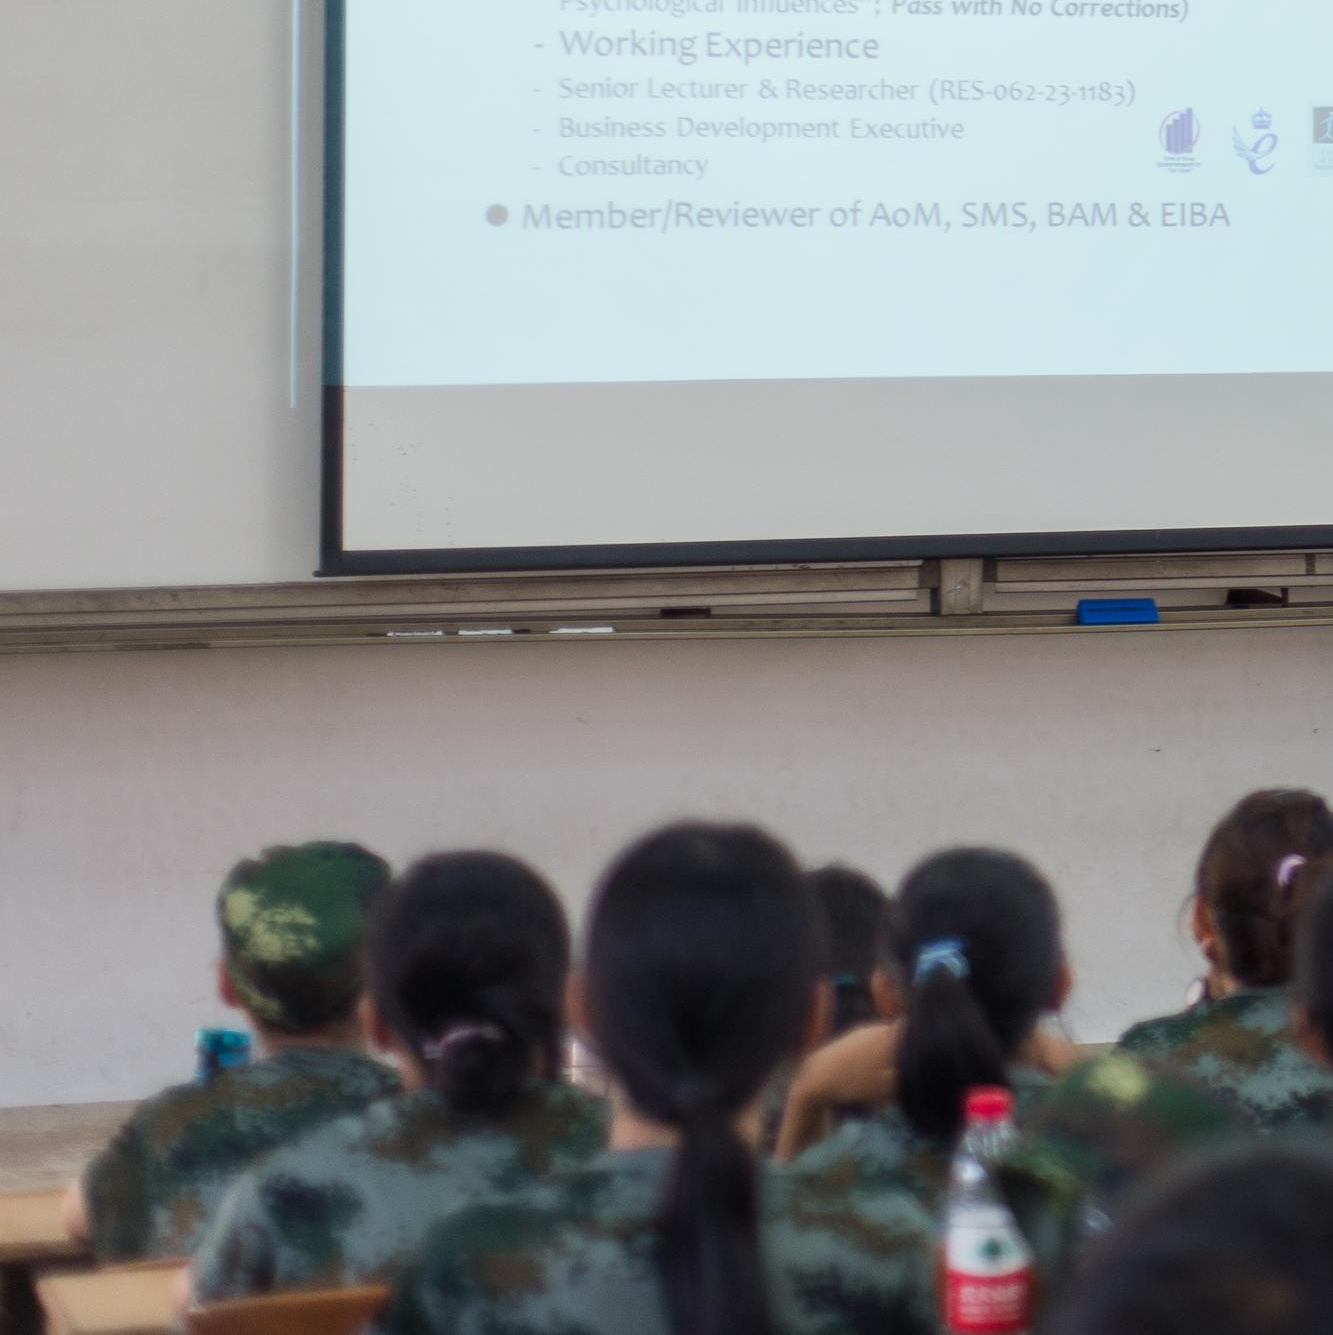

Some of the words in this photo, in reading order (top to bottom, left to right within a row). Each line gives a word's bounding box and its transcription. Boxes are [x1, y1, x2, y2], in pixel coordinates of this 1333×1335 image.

[557, 28, 699, 67] Working
[705, 31, 880, 66] Experience
[557, 76, 640, 100] Senior
[646, 77, 749, 100] Lecturer
[757, 78, 779, 100] &
[784, 78, 920, 101] Researcher
[928, 77, 1136, 108] (RES-062-23-1183)
[558, 115, 667, 139] Business
[676, 115, 841, 144] Development
[848, 117, 965, 140] Executive
[556, 152, 710, 181] Consultancy
[521, 199, 822, 233] Member/Reviewer
[827, 199, 863, 228] of
[867, 201, 952, 233] AoM,
[960, 201, 1037, 234] SMS,
[1046, 201, 1118, 228] BAM
[1126, 201, 1152, 228] &
[1160, 201, 1232, 228] EIBA
